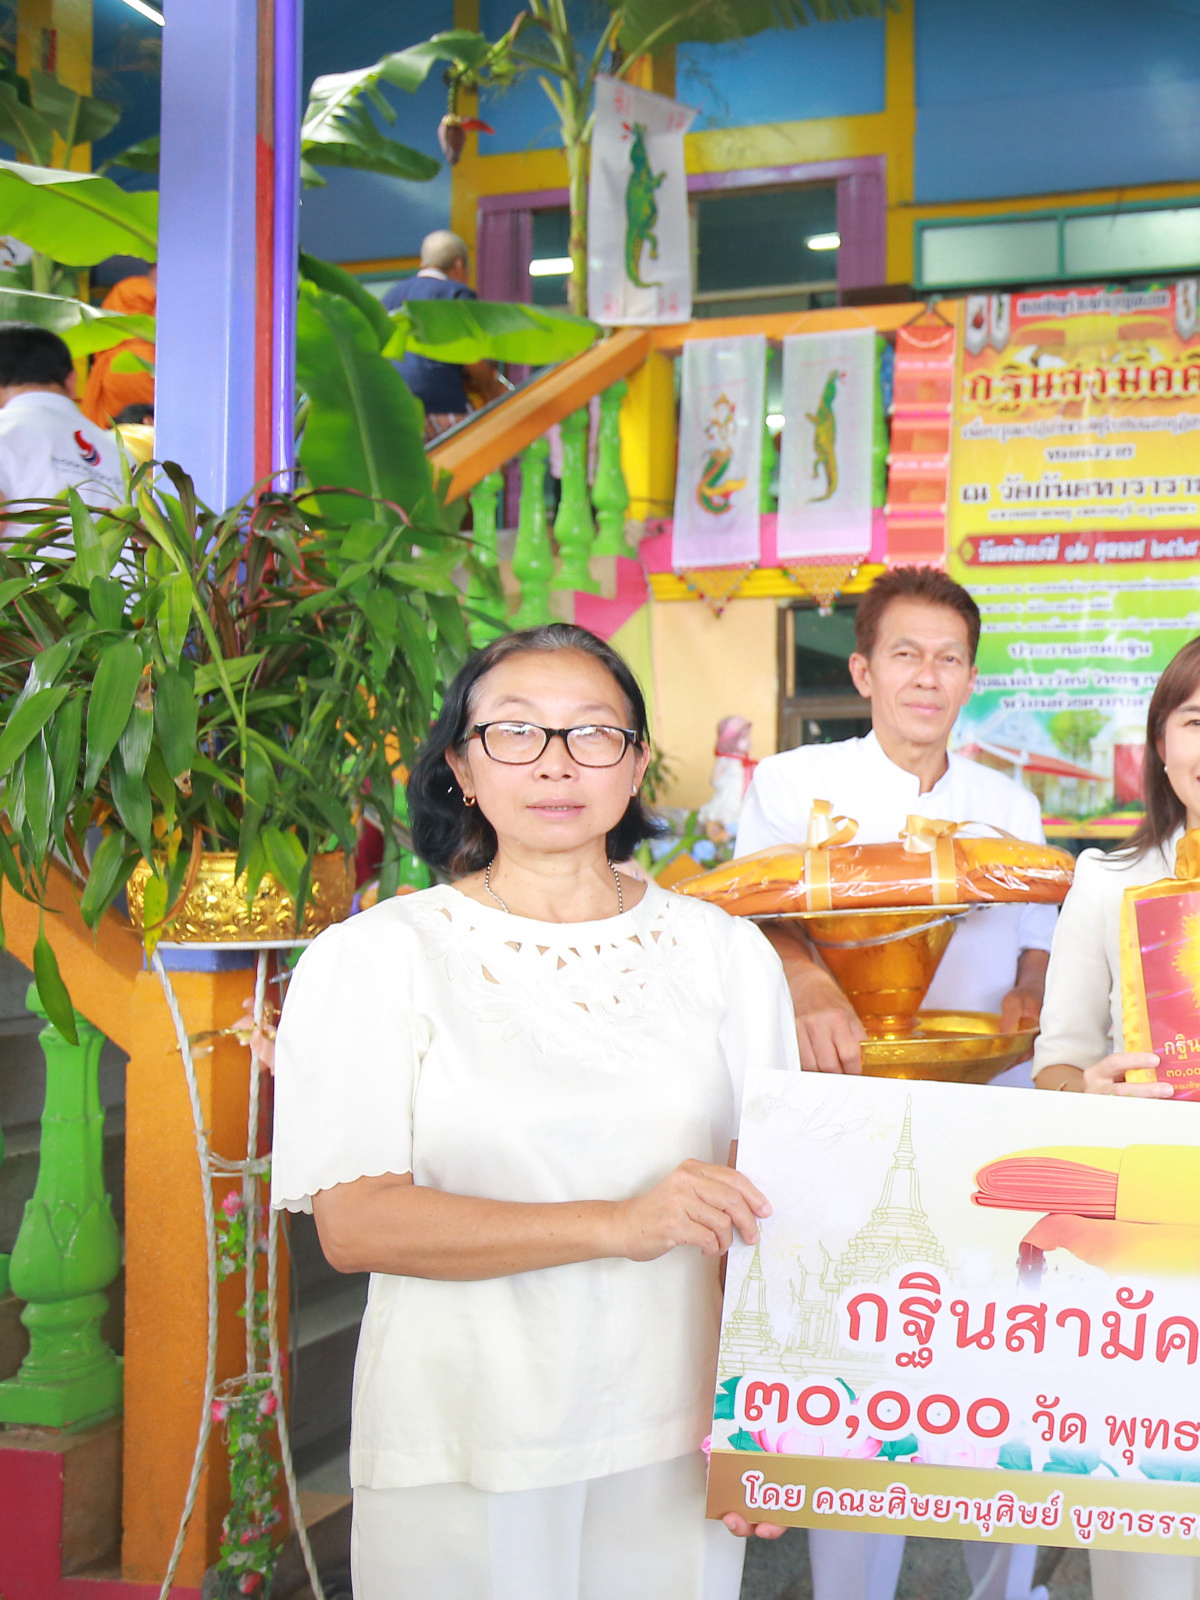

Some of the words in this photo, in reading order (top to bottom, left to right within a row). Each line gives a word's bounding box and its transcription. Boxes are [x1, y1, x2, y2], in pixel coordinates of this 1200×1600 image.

[744, 1379, 1010, 1439] ๓๐,๐๐๐
[1032, 1394, 1087, 1444] วัด
[746, 1475, 803, 1508] โดย
[816, 1486, 1062, 1532] คณะศิษยานุศิษย์
